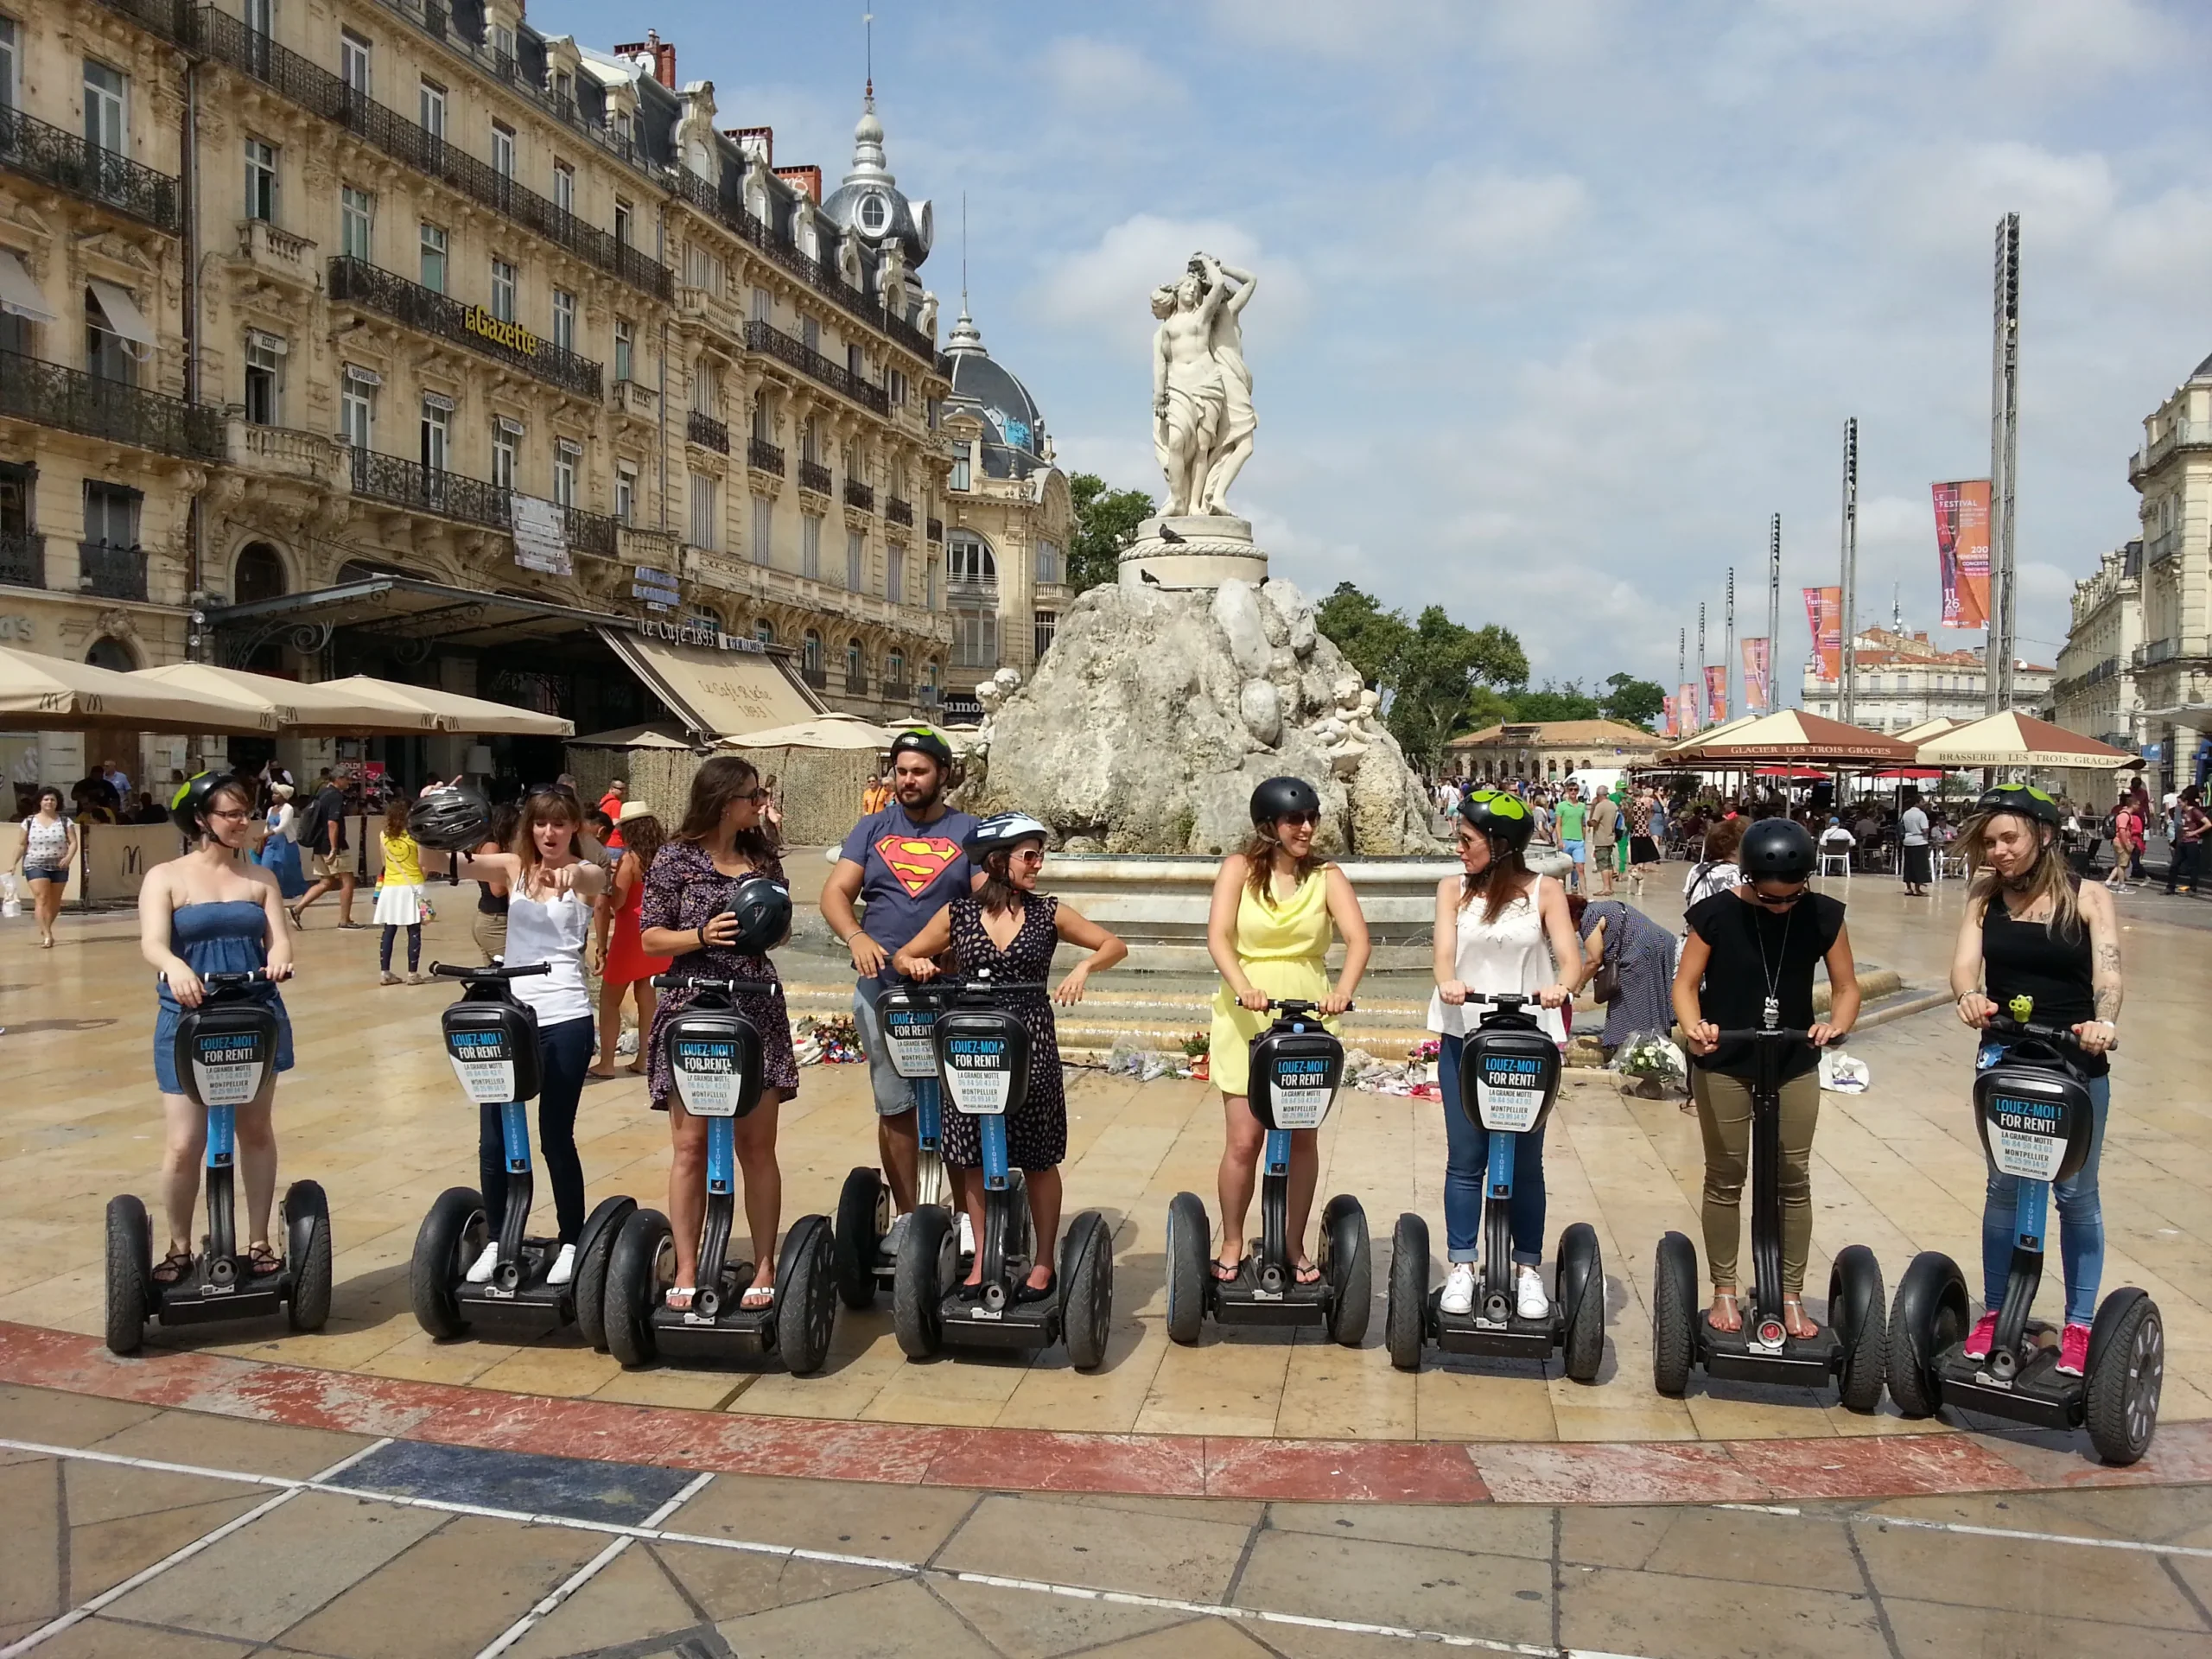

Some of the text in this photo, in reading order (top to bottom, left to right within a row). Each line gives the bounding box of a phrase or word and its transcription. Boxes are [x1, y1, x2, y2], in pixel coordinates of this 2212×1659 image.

[475, 304, 537, 357] Gazette
[1939, 499, 1978, 508] FESTIVAL
[1970, 545, 1989, 554] 200
[1944, 588, 1955, 600] 11
[1944, 598, 1961, 608] 26
[691, 628, 715, 647] 1893
[738, 705, 767, 718] 1893
[1731, 746, 1778, 754] GLACIER
[1848, 747, 1891, 755] GRACES
[1939, 753, 2119, 766] BRASSERIE LES TROIS GRACES
[889, 1012, 932, 1025] LOUEZ-MOI
[894, 1026, 911, 1037] FOR
[200, 1035, 252, 1051] LOUEZ-MOI
[451, 1033, 498, 1046] LOUEZ-MOI
[458, 1046, 502, 1059] FOR RENT!
[679, 1043, 728, 1057] LOUEZ-MOI
[950, 1040, 998, 1053] LOUEZ-MOI
[204, 1048, 253, 1063] FOR RENT!
[955, 1054, 1001, 1067] FOR RENT!
[684, 1058, 732, 1071] FOR RENT!
[1278, 1060, 1323, 1073] LOUEZ-MOI
[1485, 1058, 1535, 1073] LOUEZ-MOI
[209, 1080, 249, 1089] MONTPELLIER
[1281, 1073, 1324, 1086] FOR RENT!
[1489, 1072, 1535, 1087] FOR RENT!
[1491, 1105, 1529, 1114] MONTPELLIER
[1996, 1098, 2055, 1119] LOUEZ-MOI
[2000, 1113, 2056, 1134] FOR RENT!
[2010, 1132, 2033, 1142] GRANDE
[2034, 1136, 2053, 1146] MOTTE
[2005, 1148, 2050, 1162] MONTPELLIER
